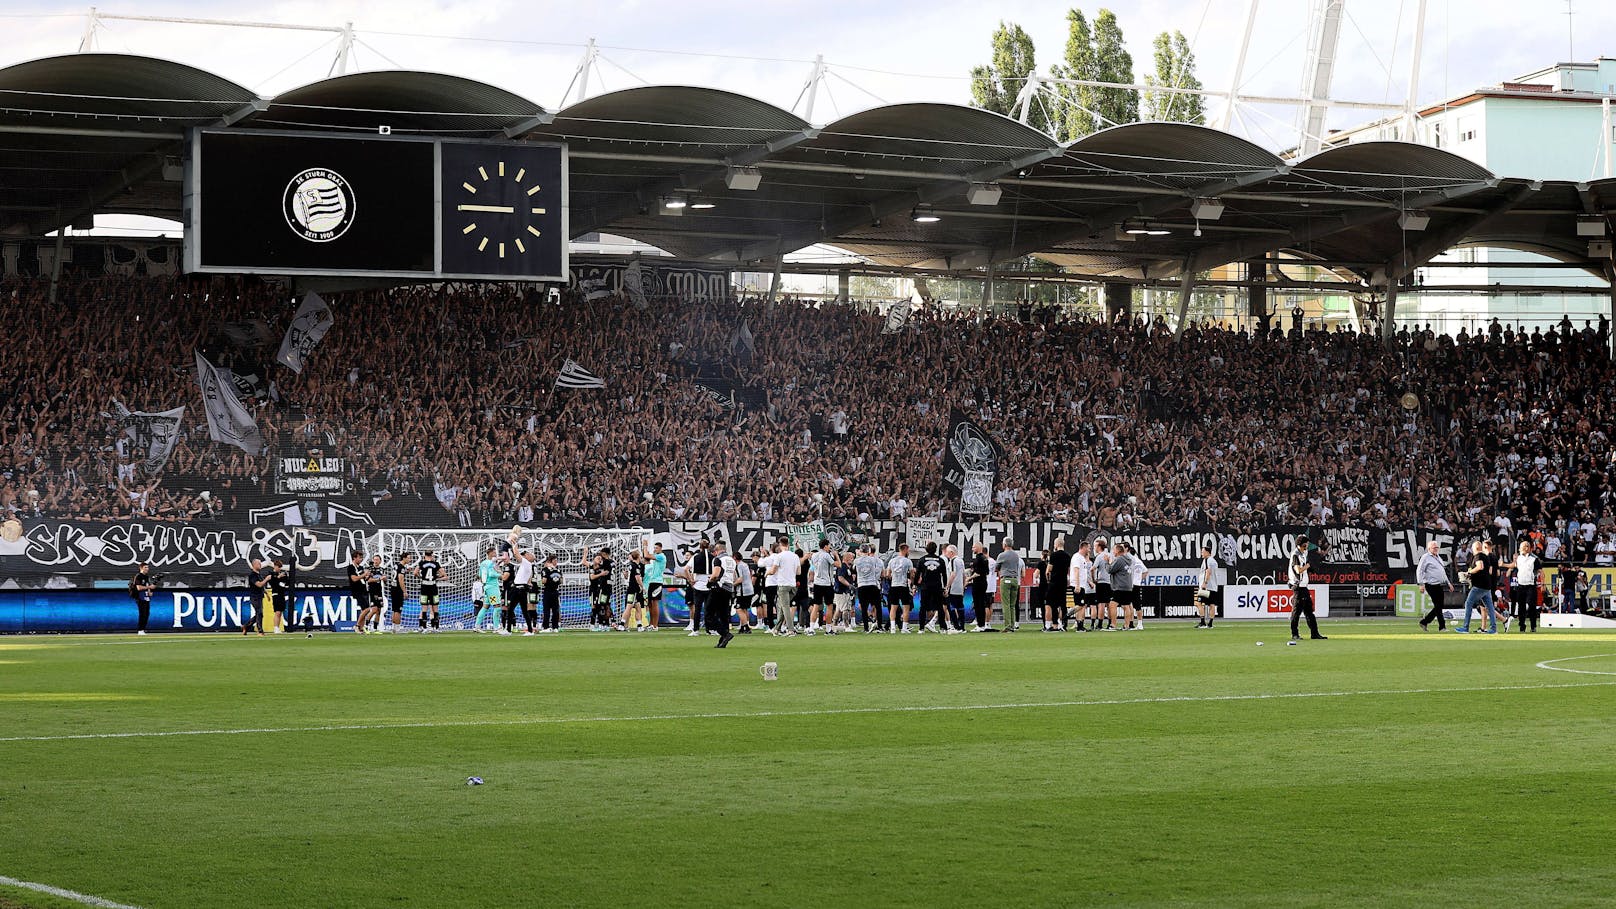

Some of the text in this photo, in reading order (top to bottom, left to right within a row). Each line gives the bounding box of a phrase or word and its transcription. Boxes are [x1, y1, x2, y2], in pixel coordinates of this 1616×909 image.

[296, 176, 305, 185] SK
[26, 524, 93, 566] SK
[425, 567, 434, 581] 4
[1175, 576, 1199, 586] GRA
[1237, 591, 1265, 612] sky
